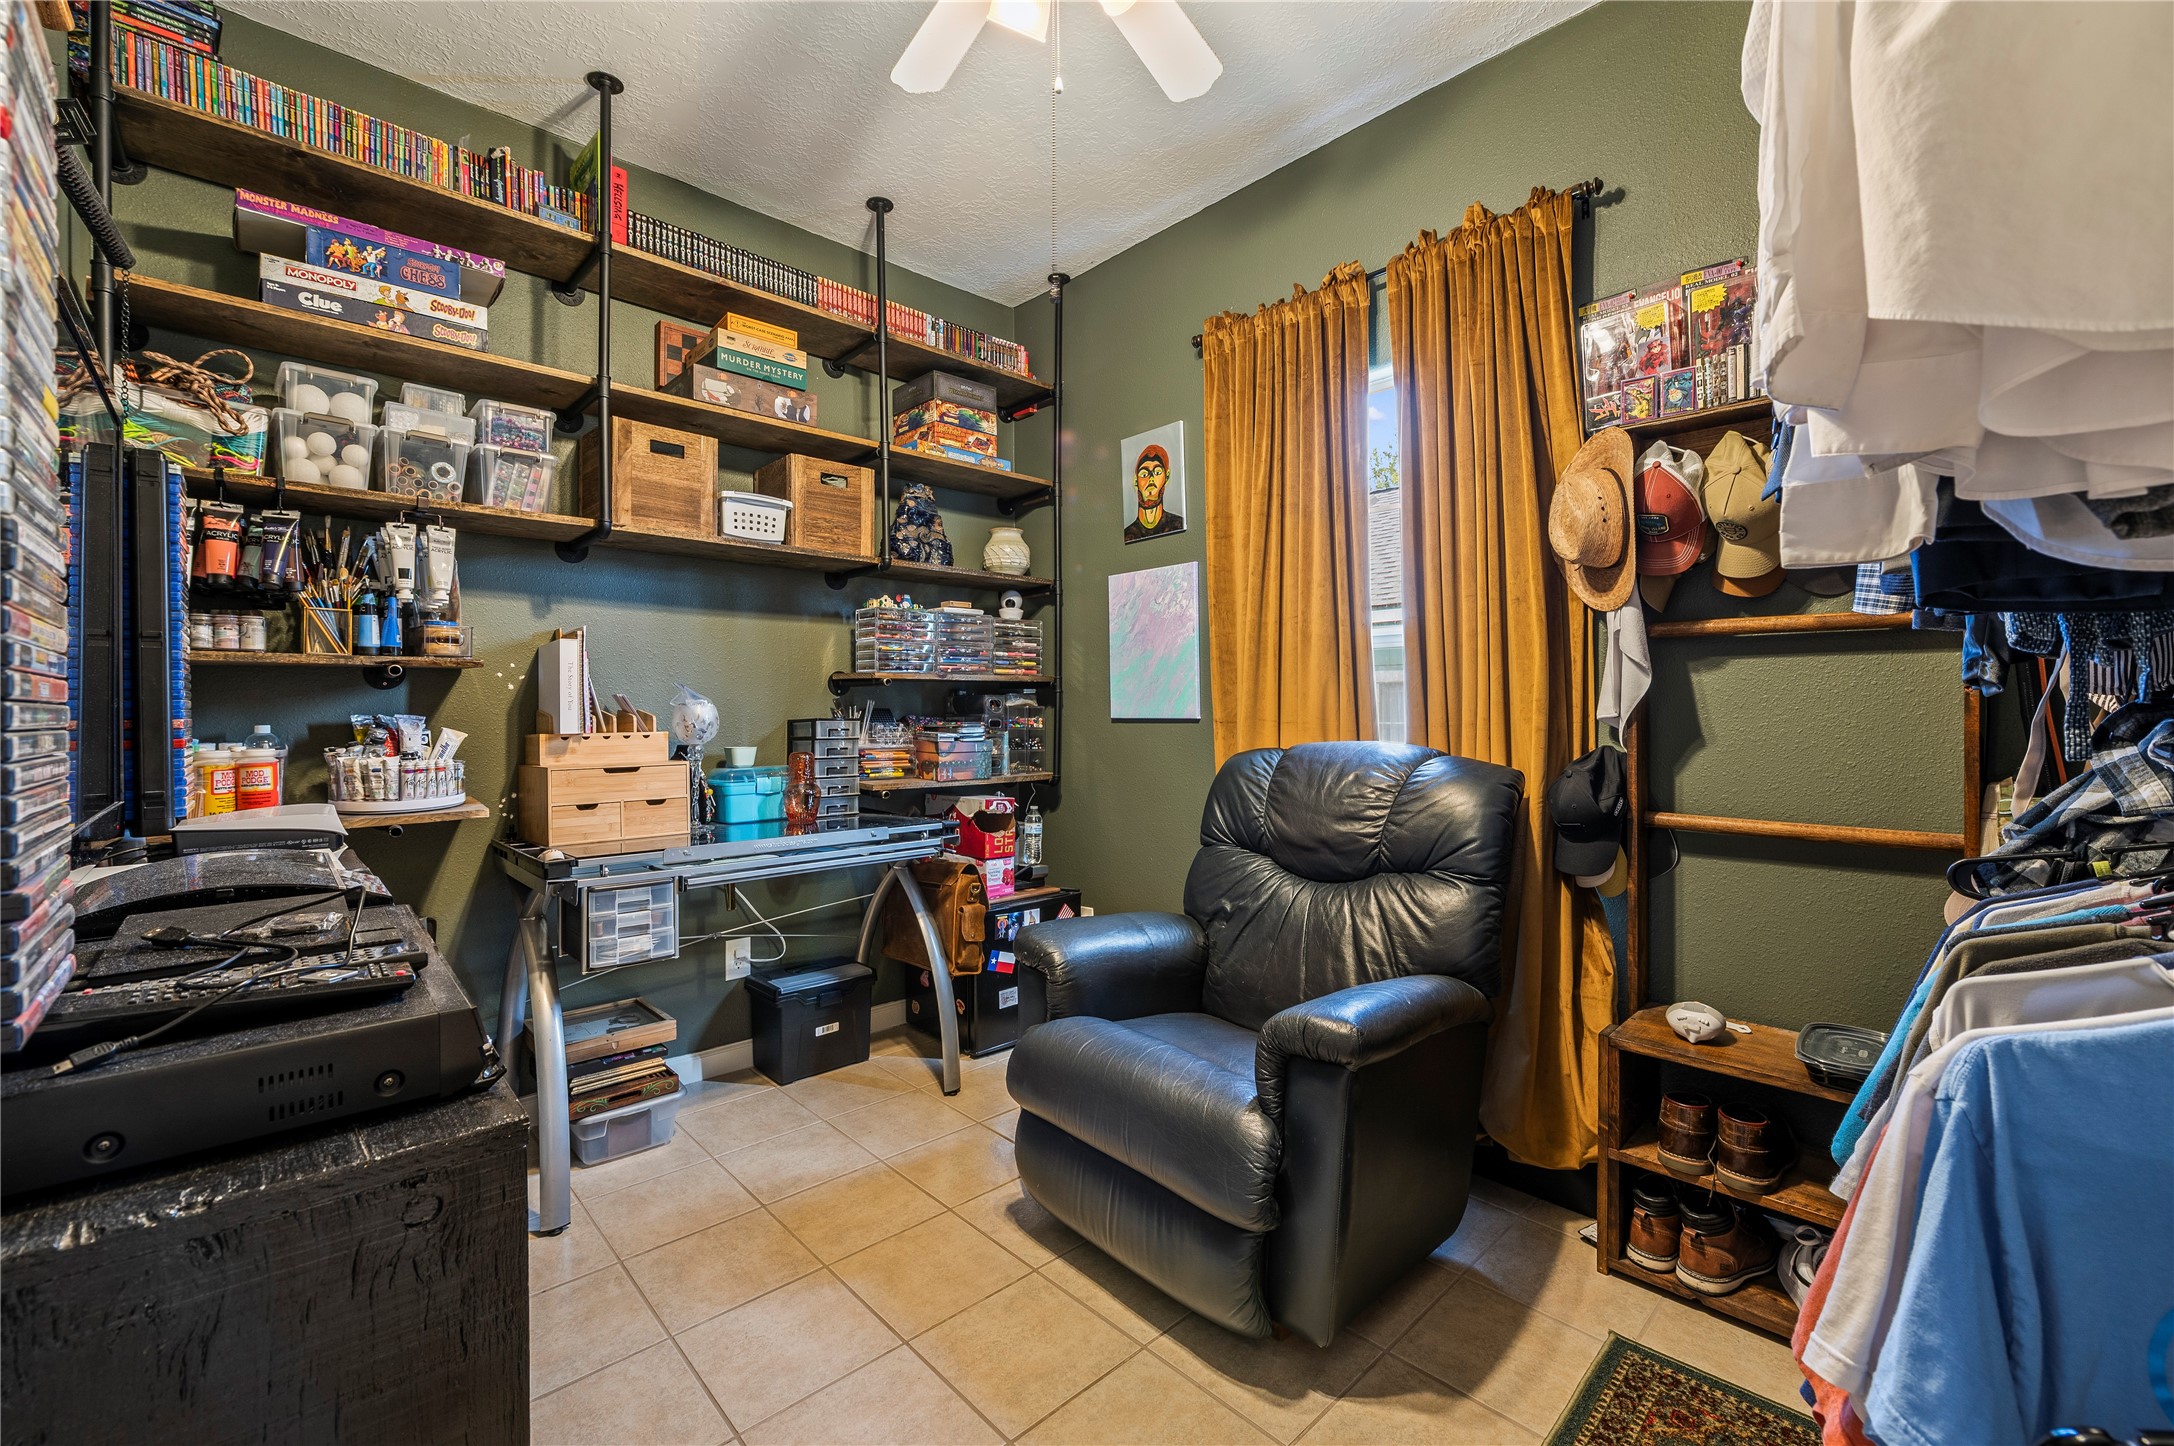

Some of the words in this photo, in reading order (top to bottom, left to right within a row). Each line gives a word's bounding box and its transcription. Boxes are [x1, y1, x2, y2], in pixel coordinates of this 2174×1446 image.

[239, 190, 287, 211] MONSTER
[290, 203, 339, 224] MADNESS
[287, 267, 356, 290] MONOPOLY
[400, 265, 447, 290] CHESS
[297, 291, 343, 312] Clue
[1634, 287, 1681, 309] EVANGELIO
[430, 299, 476, 321] SCOOBY-DOO!
[432, 323, 477, 345] SCOOBY-DOO!
[720, 352, 762, 370] MURDER
[763, 364, 804, 381] MYSTERY
[207, 530, 238, 540] ACRYLIC
[215, 779, 235, 787] PODG
[242, 776, 269, 784] PODGE
[245, 769, 264, 778] MOD
[994, 837, 1004, 854] LO
